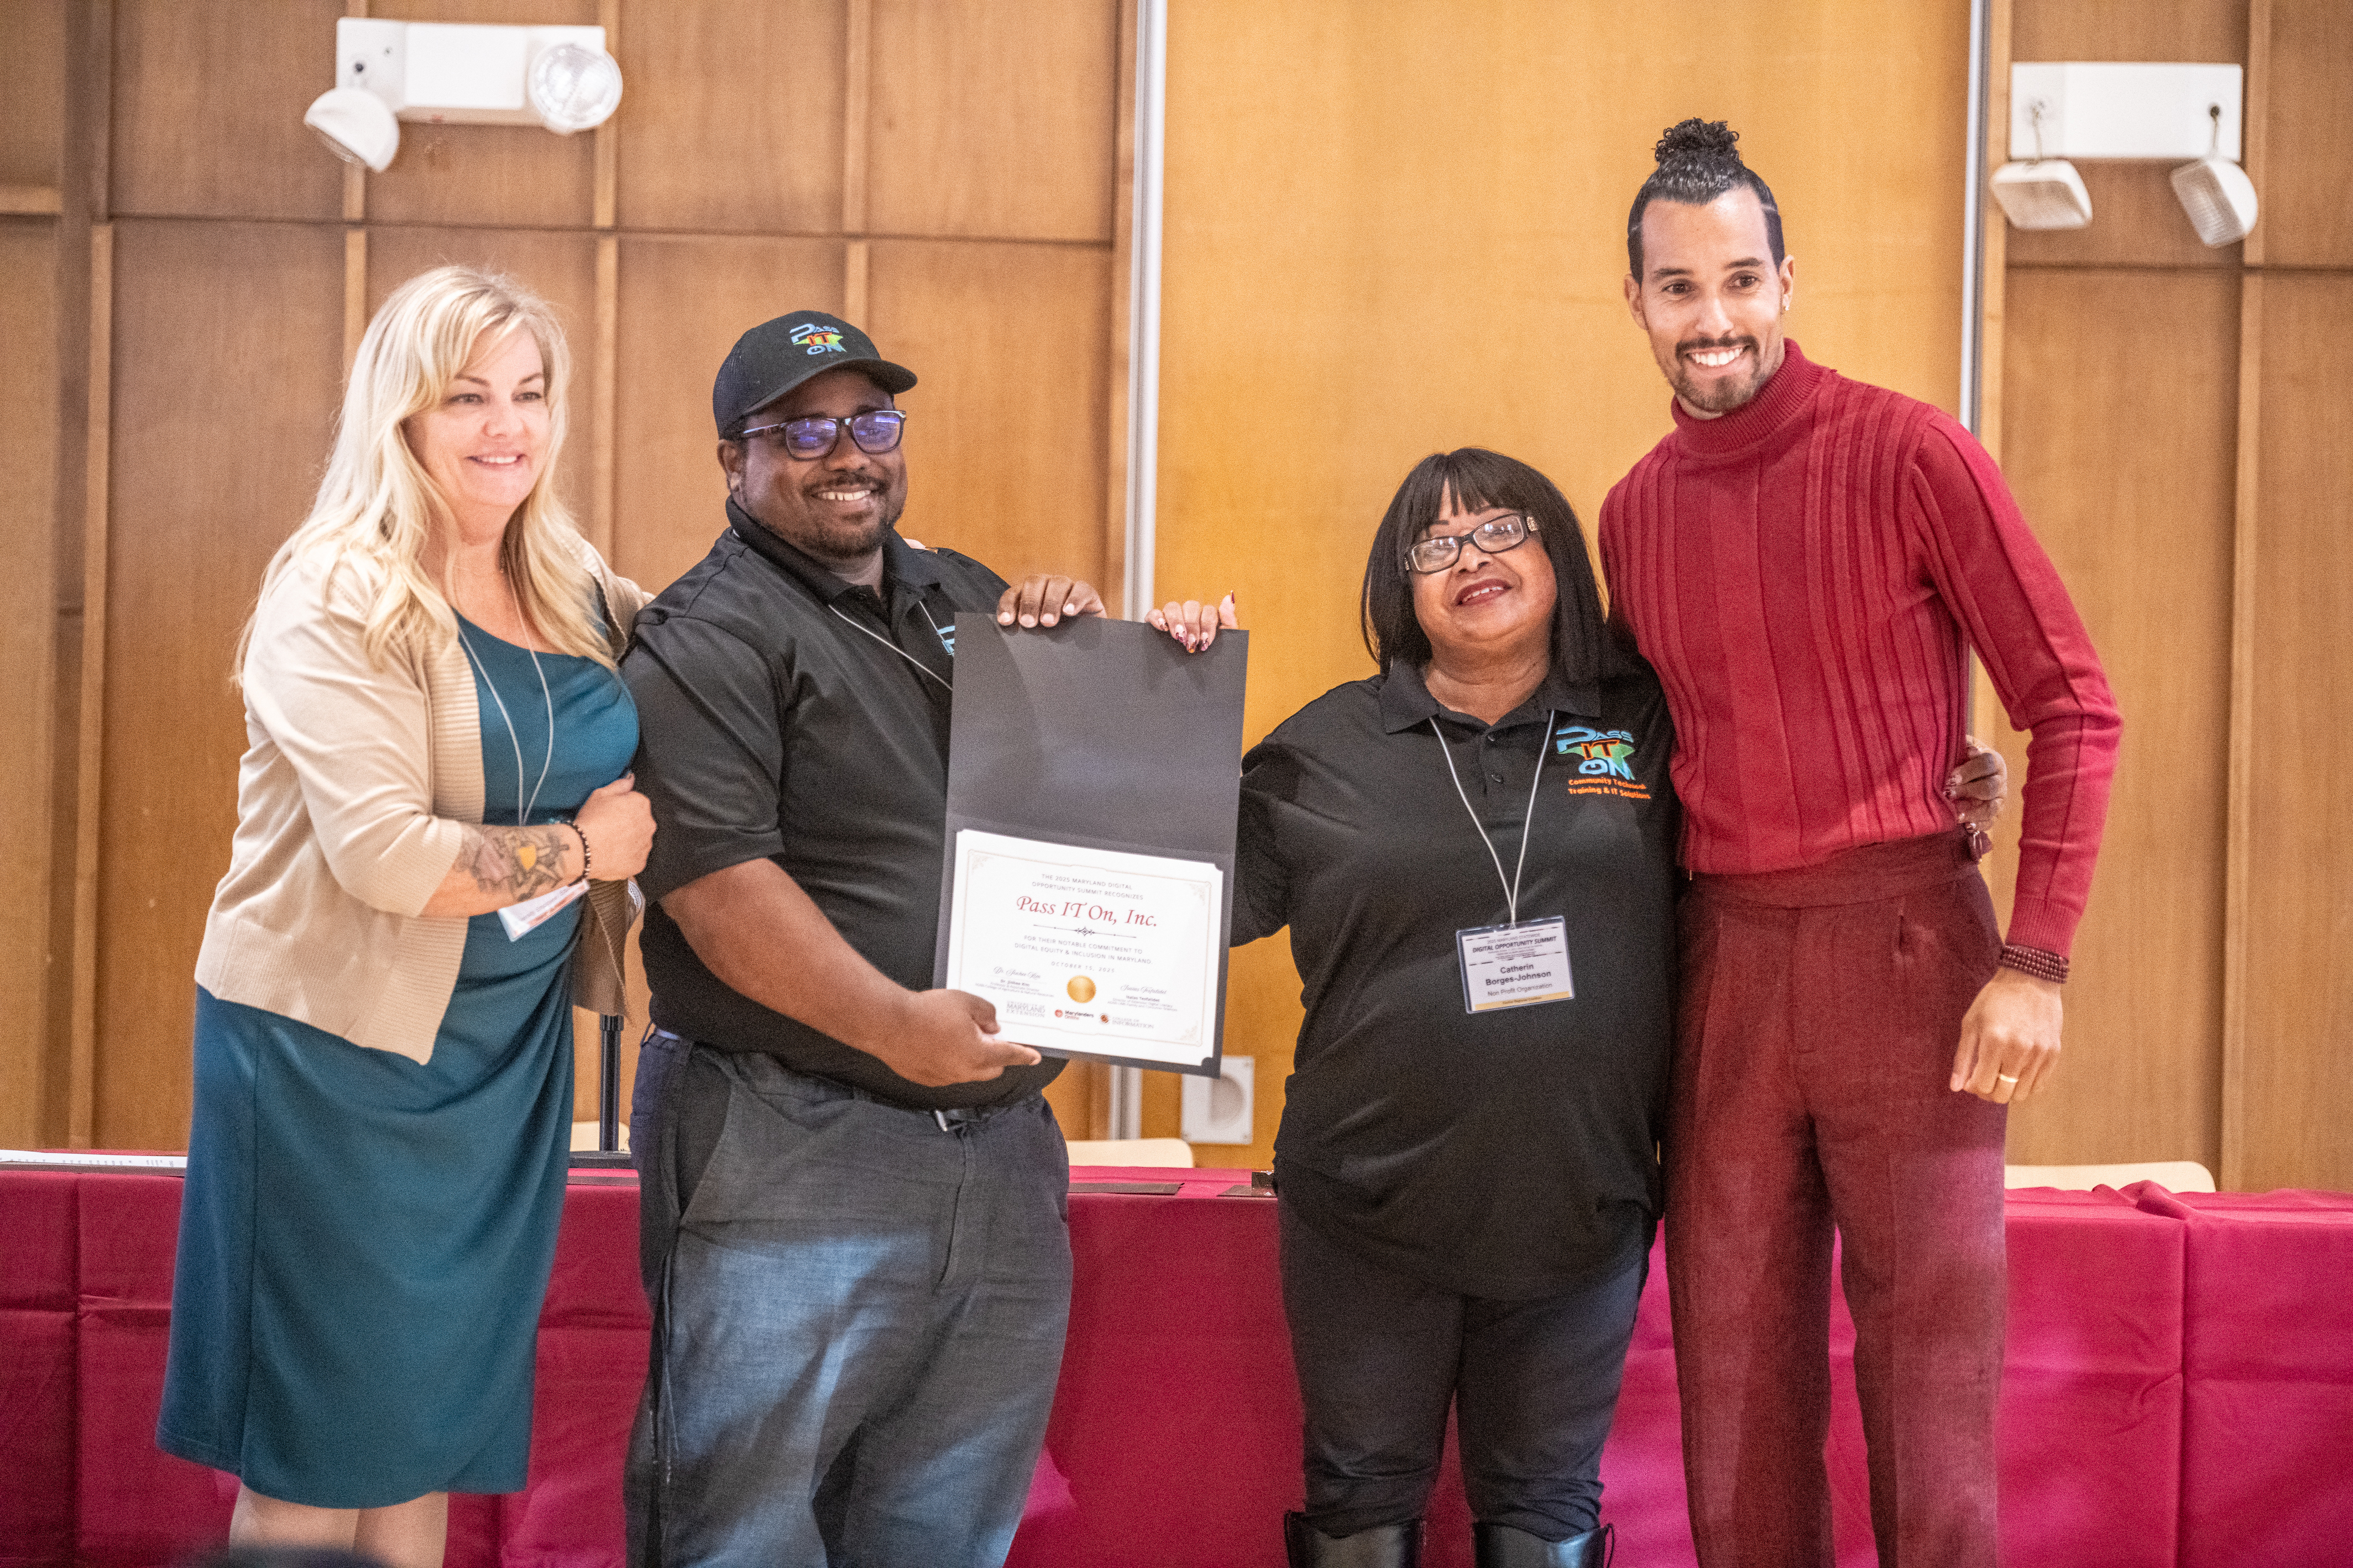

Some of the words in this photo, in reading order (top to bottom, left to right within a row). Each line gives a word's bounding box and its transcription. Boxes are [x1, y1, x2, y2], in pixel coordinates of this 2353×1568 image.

[807, 332, 833, 347] IT
[1581, 739, 1620, 760] IT
[1578, 758, 1631, 780] ON
[1568, 777, 1612, 785] Community
[1568, 786, 1602, 795] Training
[1072, 878, 1106, 887] MARYLAND
[1032, 882, 1075, 891] OPPORTUNITY
[1105, 891, 1143, 900] RECOGNIZES
[1016, 895, 1056, 915] Pass
[1060, 902, 1087, 918] IT
[1089, 905, 1117, 925] On,
[1125, 909, 1157, 927] Inc.
[1058, 940, 1086, 948] NOTABLE
[1089, 943, 1132, 953] COMMITMENT
[1495, 940, 1533, 950] OPPORTUNITY
[1534, 936, 1557, 945] SUMMIT
[1015, 942, 1038, 951] DIGITAL
[1040, 946, 1063, 955] EQUITY
[1071, 950, 1106, 959] INCLUSION
[1117, 956, 1153, 964] MARYLAND.
[1500, 963, 1534, 974] Catherin
[1486, 971, 1551, 985] Borges-Johnson
[1517, 983, 1552, 993] Organization
[1006, 1009, 1045, 1018] EXTENSION
[1007, 1003, 1045, 1013] MARYLAND
[1112, 1020, 1154, 1029] INFORMATION
